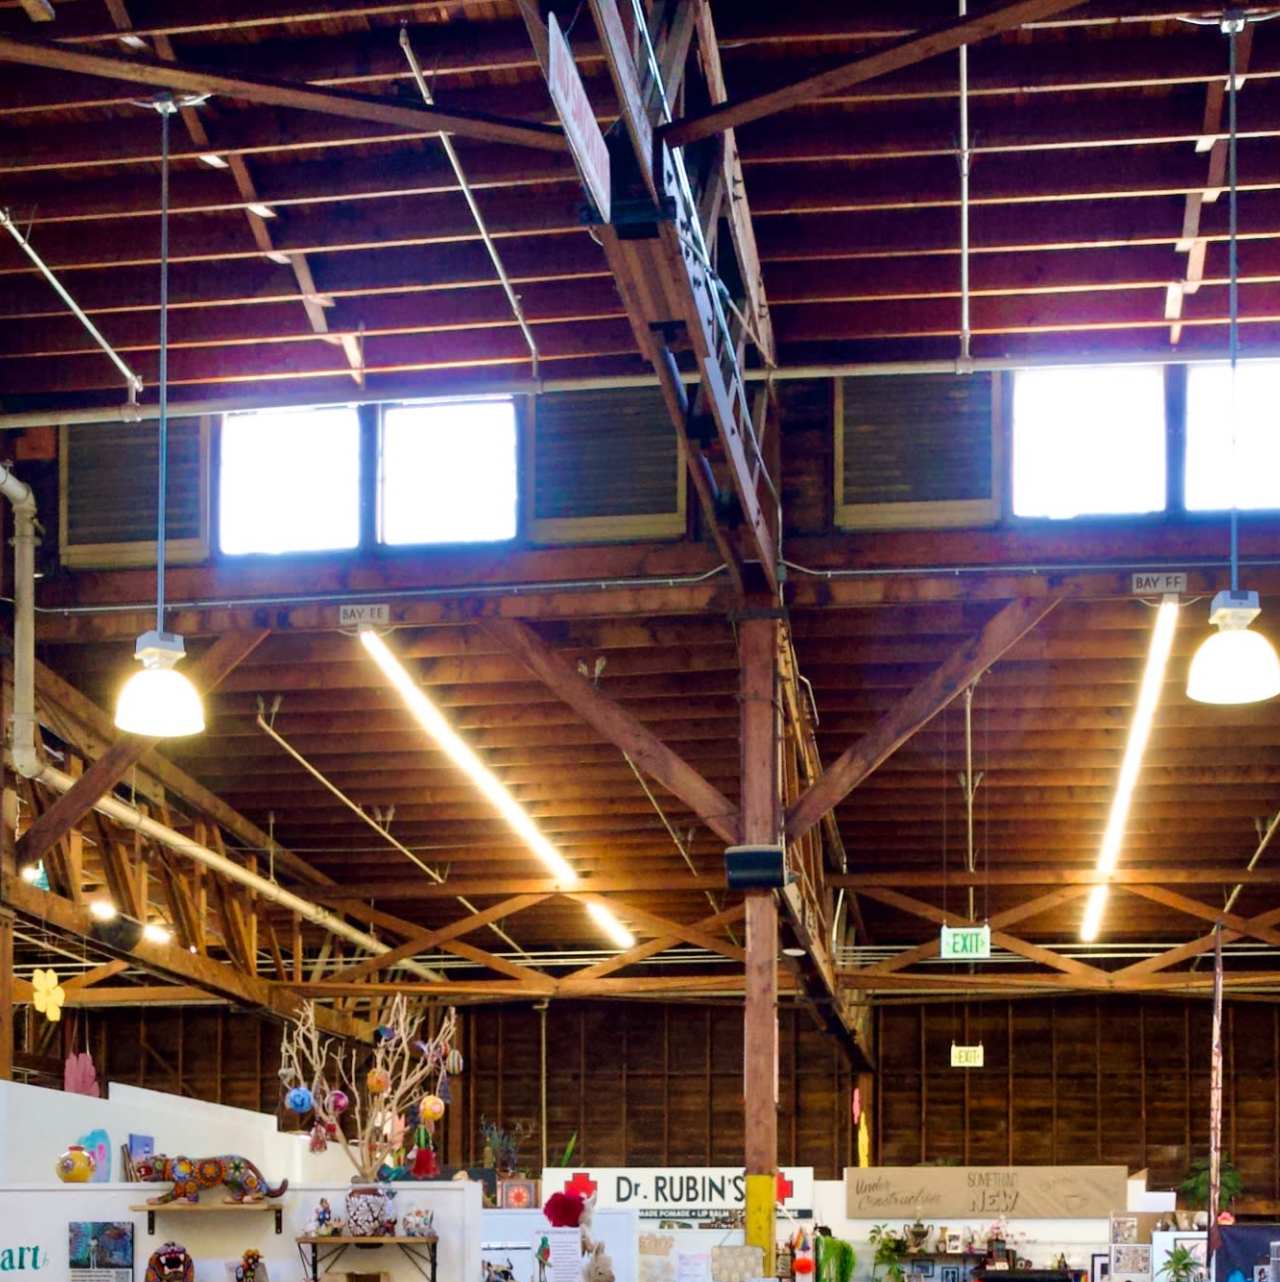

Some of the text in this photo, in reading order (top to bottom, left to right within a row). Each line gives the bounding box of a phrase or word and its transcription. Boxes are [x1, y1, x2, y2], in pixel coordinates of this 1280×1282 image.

[1136, 575, 1182, 589] BAY FF
[342, 608, 365, 620] BAY
[952, 933, 981, 953] EXIT
[616, 1176, 746, 1202] Dr. RUBIN'S
